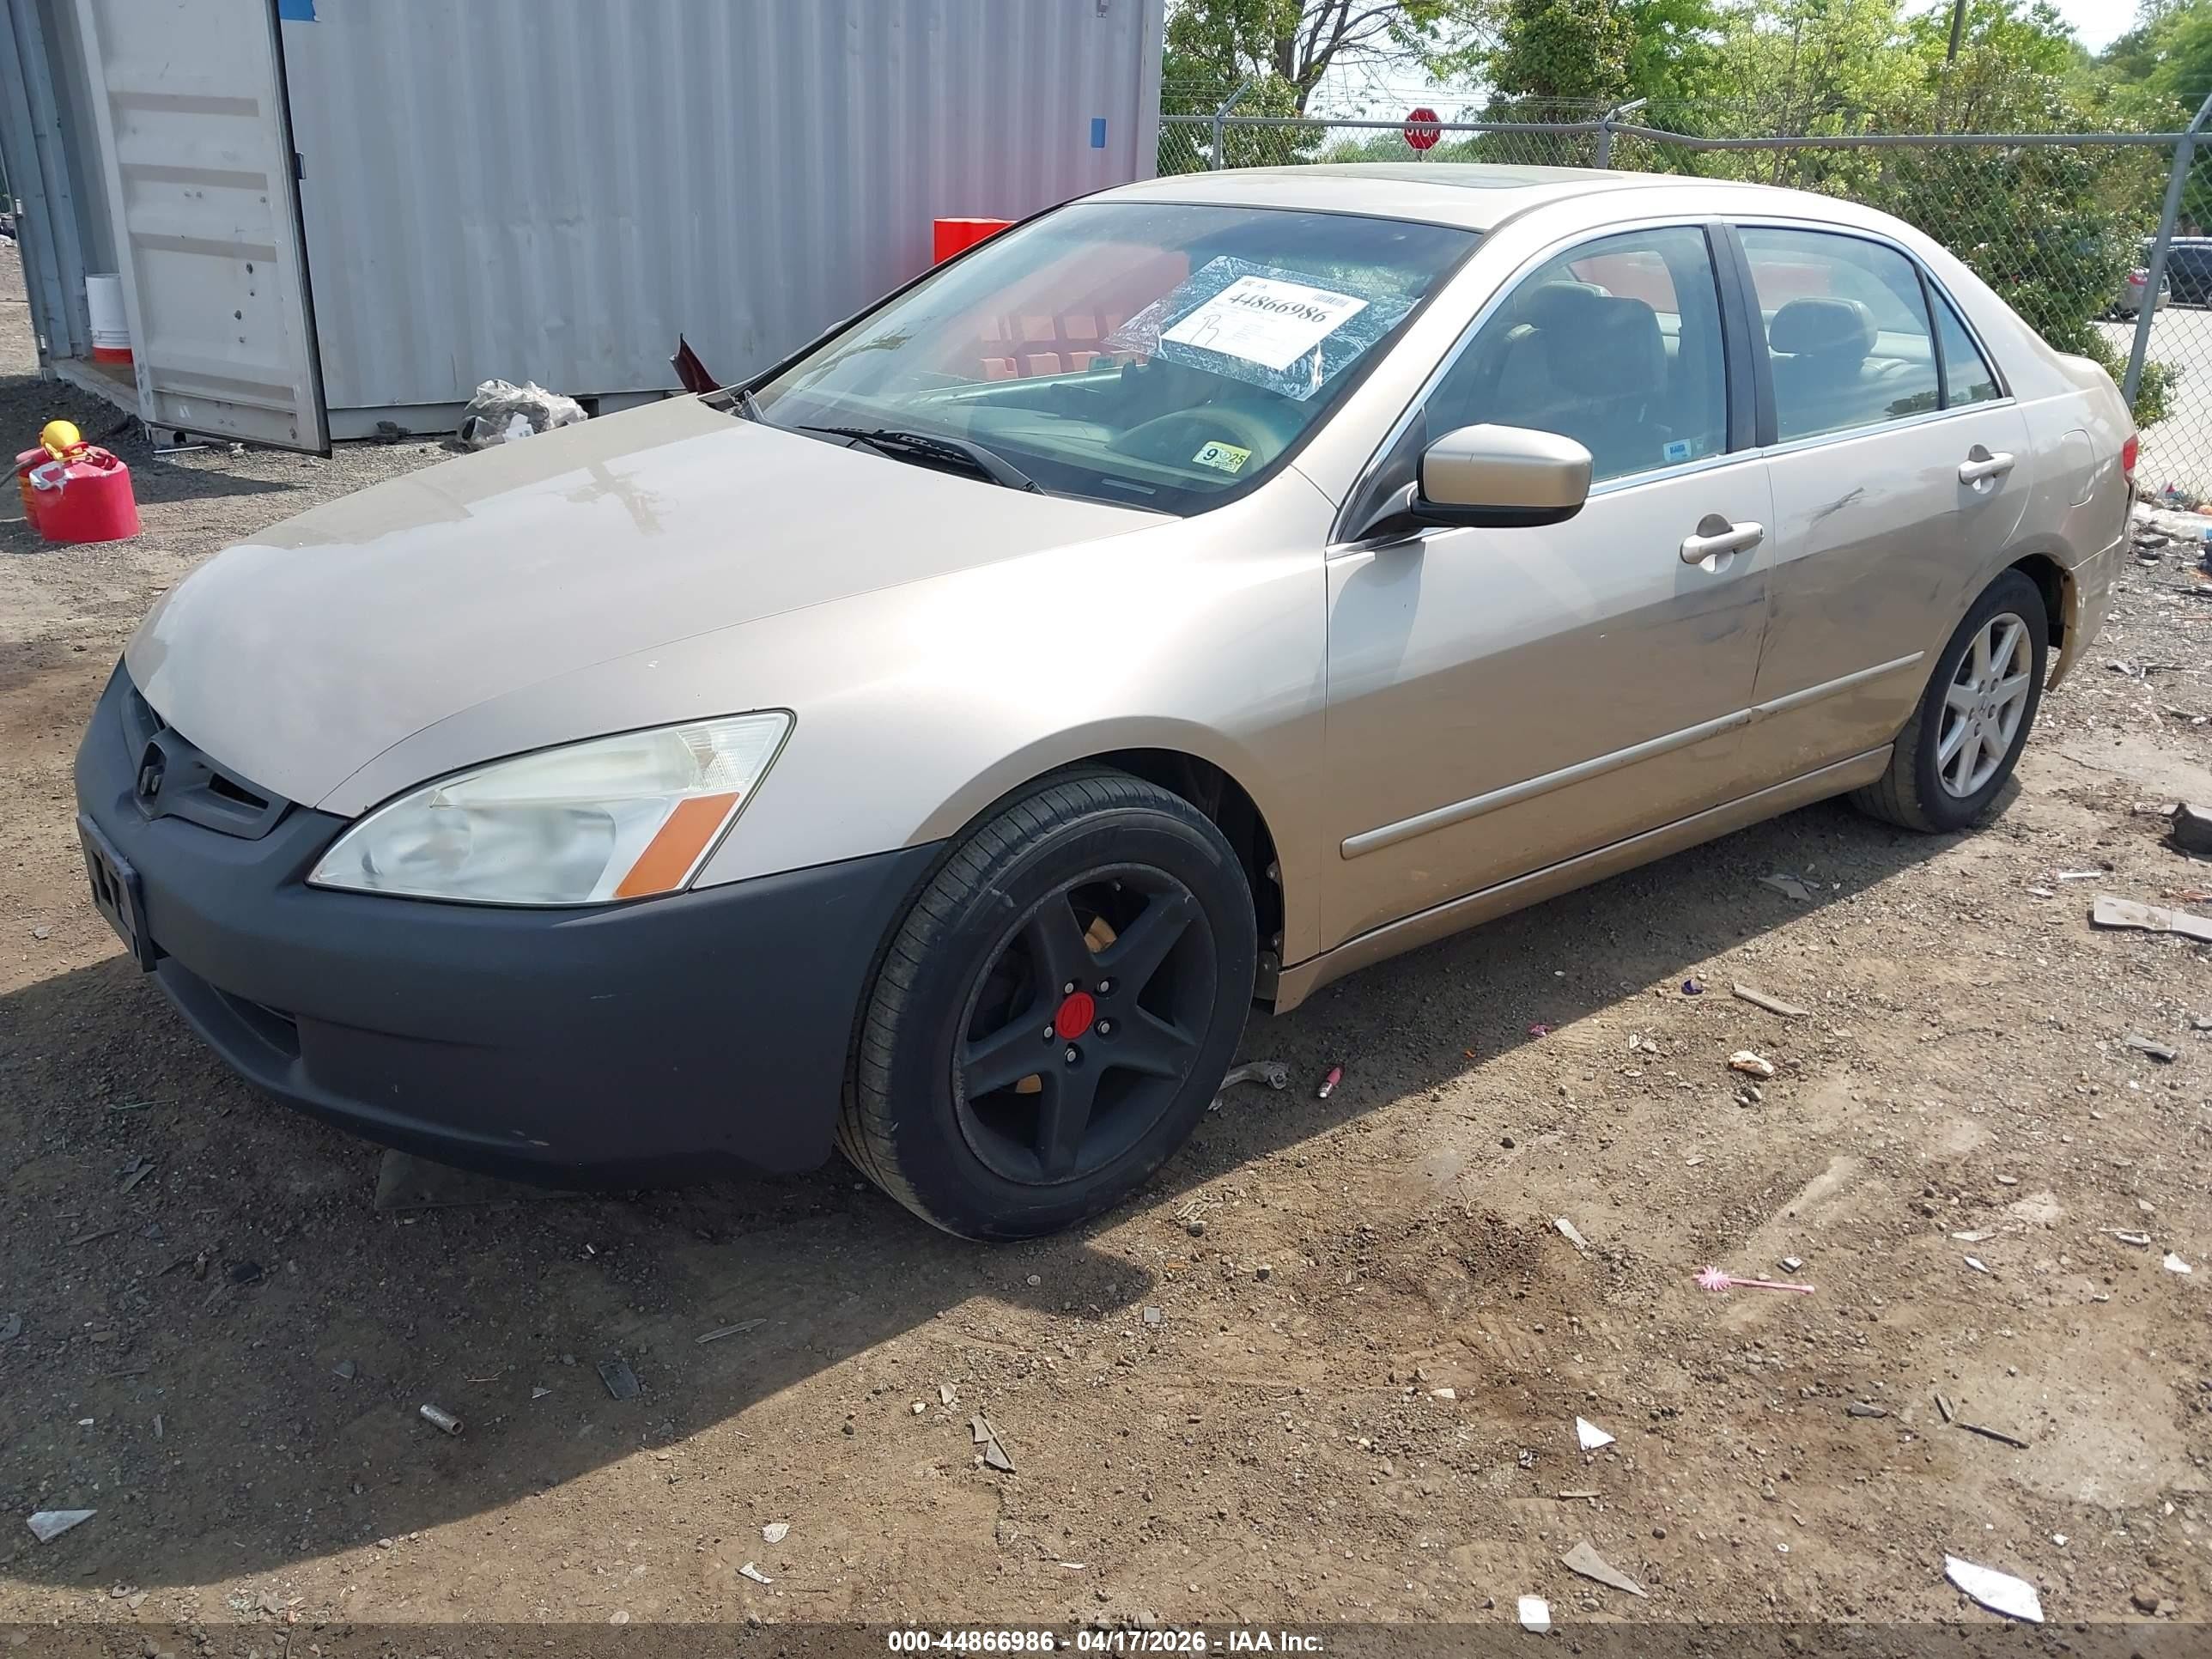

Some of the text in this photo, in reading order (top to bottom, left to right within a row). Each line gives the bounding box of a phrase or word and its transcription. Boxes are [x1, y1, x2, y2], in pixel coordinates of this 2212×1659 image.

[1229, 292, 1332, 323] 44866986
[1203, 448, 1246, 465] 9 25
